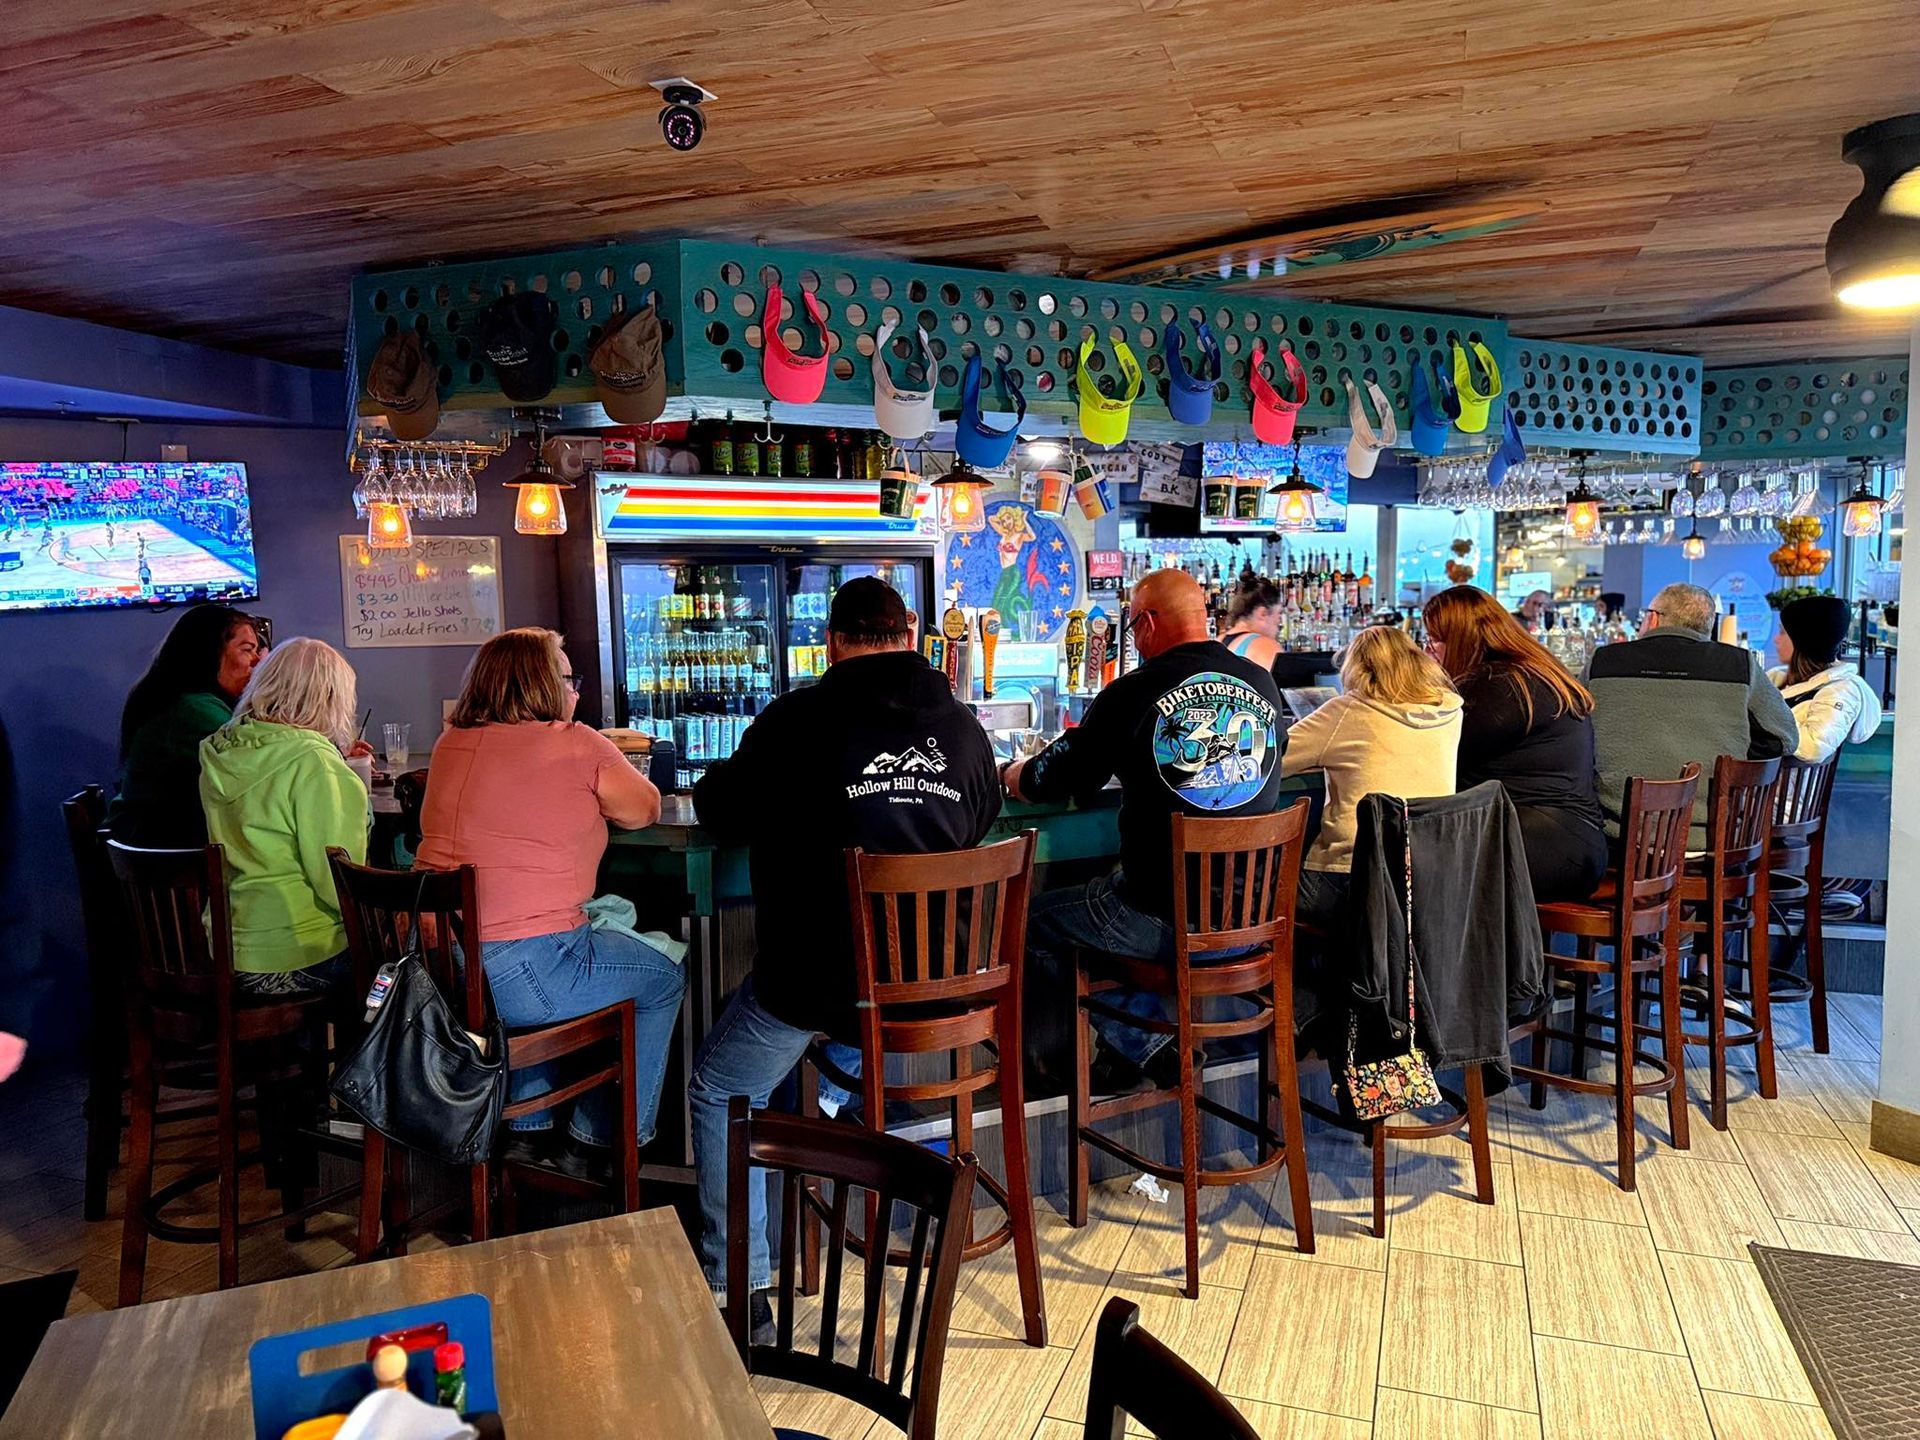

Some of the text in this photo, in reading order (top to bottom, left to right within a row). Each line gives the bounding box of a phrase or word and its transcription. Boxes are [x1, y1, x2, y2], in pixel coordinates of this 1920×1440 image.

[1141, 448, 1168, 463] CODY
[65, 589, 76, 597] 26
[403, 607, 432, 621] Jello
[434, 605, 463, 617] Shots
[352, 623, 374, 641] Try
[380, 622, 425, 638] Loaded
[426, 623, 459, 636] Fries
[1156, 682, 1277, 723] BIKETOBERFEST
[1175, 695, 1268, 719] DAYTONA BEACH
[1187, 711, 1213, 720] 2022
[845, 777, 962, 802] Hollow Hill Outdoors
